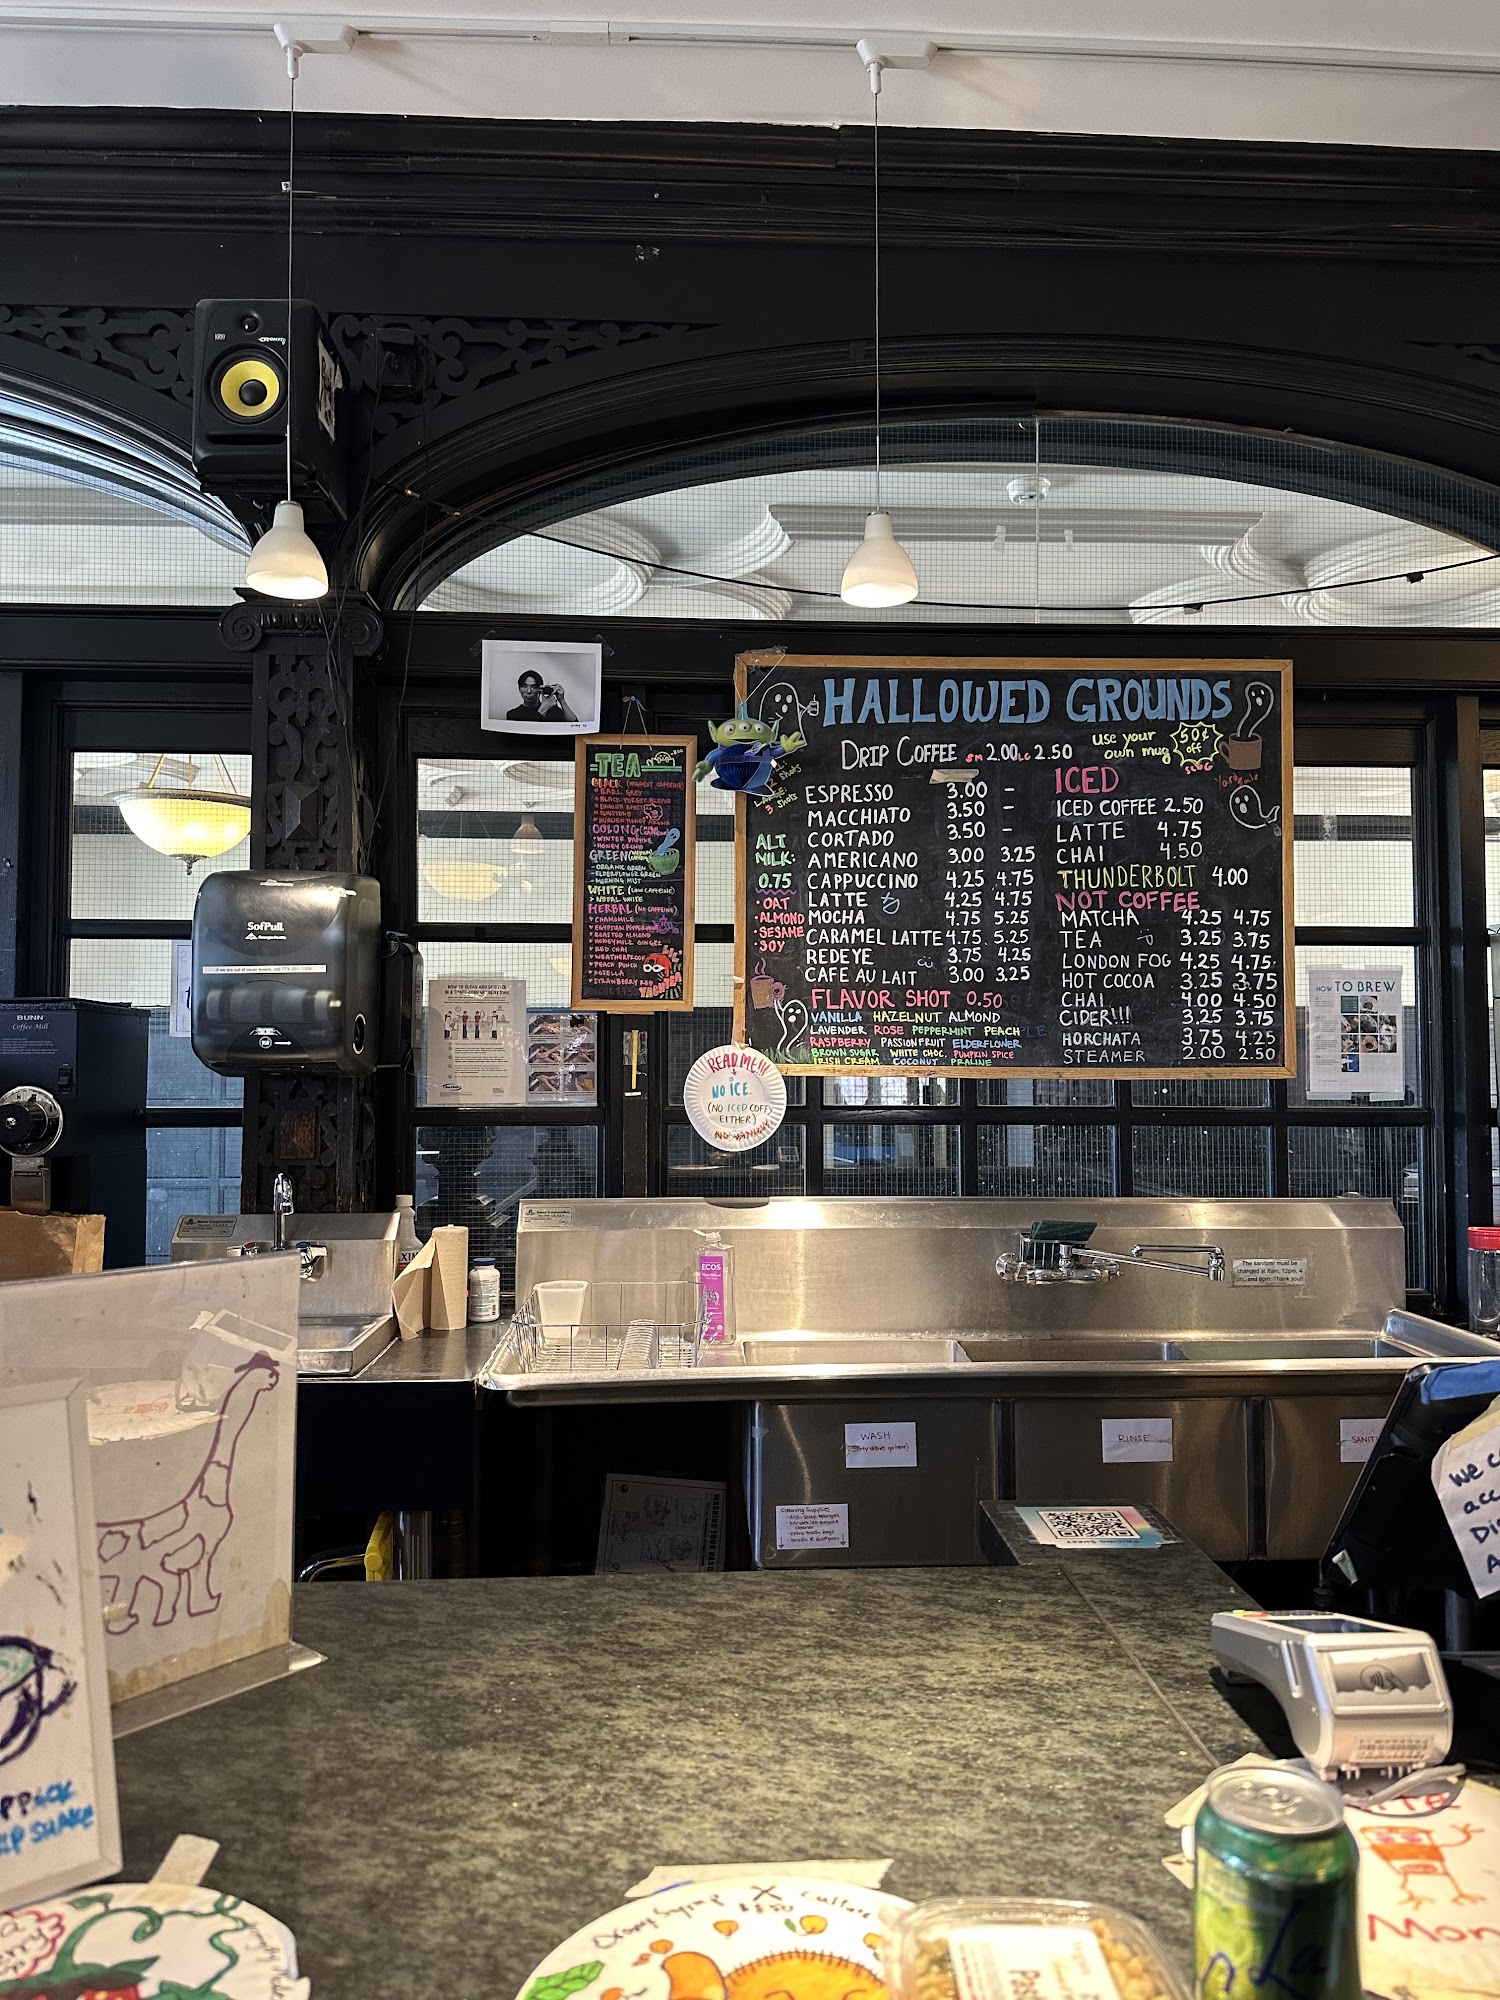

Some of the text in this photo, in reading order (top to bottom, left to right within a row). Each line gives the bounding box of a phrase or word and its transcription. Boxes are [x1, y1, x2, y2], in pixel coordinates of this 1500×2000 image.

[823, 678, 1232, 727] HALLOWED GROUNDS
[1093, 731, 1156, 749] use your
[1186, 742, 1202, 754] off
[842, 740, 889, 770] DRIP
[897, 736, 957, 766] COFFEE
[986, 743, 1018, 761] 2.00
[1034, 744, 1072, 759] 2.50
[1104, 746, 1171, 764] own mug
[595, 752, 641, 778] TEA
[592, 778, 622, 788] BLACK
[1055, 766, 1118, 794] ICED
[805, 781, 987, 804] ESPRESSO 3.00
[808, 801, 984, 827] MACCHIATO 3.50
[1057, 797, 1203, 817] ICED COFFEE 2.50
[592, 824, 641, 837] OOLONG
[808, 821, 985, 848] CORTADO 3.50
[1057, 821, 1202, 842] LATTE 4.75
[756, 834, 786, 850] ALT
[590, 850, 628, 862] GREEN
[808, 846, 1035, 869] AMERICANO 3.00 3.25
[1057, 842, 1202, 864] CHAI 4.50
[759, 873, 791, 889] 0.75
[807, 869, 1034, 890] CAPPUCCINO 4.25 4.75
[1057, 864, 1248, 890] THUNDERBOLT 4.00
[588, 884, 624, 896] WHITE
[763, 897, 790, 910] OAT
[809, 891, 1032, 908] LATTE 4.25 4.75
[1055, 890, 1200, 912] NOT COFFEE
[588, 904, 632, 914] HERBAL
[809, 910, 1029, 926] MOCHA 4.75 5.25
[1062, 908, 1271, 928] MATCHA 4.25 4.75
[246, 920, 284, 932] SofPull
[760, 912, 805, 925] ALMOND
[759, 926, 804, 938] SESAME
[806, 928, 1029, 946] CARAMEL LATTE 4.75 5.25
[1059, 929, 1270, 949] TEA 3.25 3.75
[760, 940, 785, 952] SOY
[807, 947, 1031, 965] REDEYE 3.75 4.25
[1063, 952, 1271, 971] LONDON FOG 4.25 4.75
[805, 966, 1030, 985] CAFE AU LAIT 3.00 3.25
[1062, 971, 1277, 990] HOT COCOA 3.25 3.75
[1334, 980, 1353, 992] TO
[1356, 980, 1396, 992] BREW
[812, 989, 1002, 1009] FLAVOR SHOT 0.50
[1062, 992, 1276, 1008] CHAI 4.00 4.50
[811, 1010, 1000, 1025] VANILLA HAZELNUT ALMOND
[1059, 1006, 1274, 1027] CIDER!!! 3.25 3.75
[12, 1022, 50, 1032] Coffee Mill
[810, 1022, 1020, 1036] LAVENDER ROSE PEPPERMINT PEACH
[810, 1036, 870, 1048] RASPBERRY
[953, 1039, 1022, 1049] ELDERFLOWER
[1063, 1027, 1275, 1046] HORCHATA 3.75 4.25
[708, 1052, 739, 1073] READ
[811, 1048, 1014, 1059] BROWN SUGAR WHITE CHOC. PUMPKIN SPICE
[813, 1058, 992, 1067] IRISH CREAM COCONUT PRALINE
[1063, 1046, 1275, 1064] STEAMER 2.00 2.50
[712, 1086, 726, 1099] NO
[727, 1104, 748, 1112] ICED
[860, 1431, 891, 1440] WASH
[1118, 1434, 1150, 1443] RINSE
